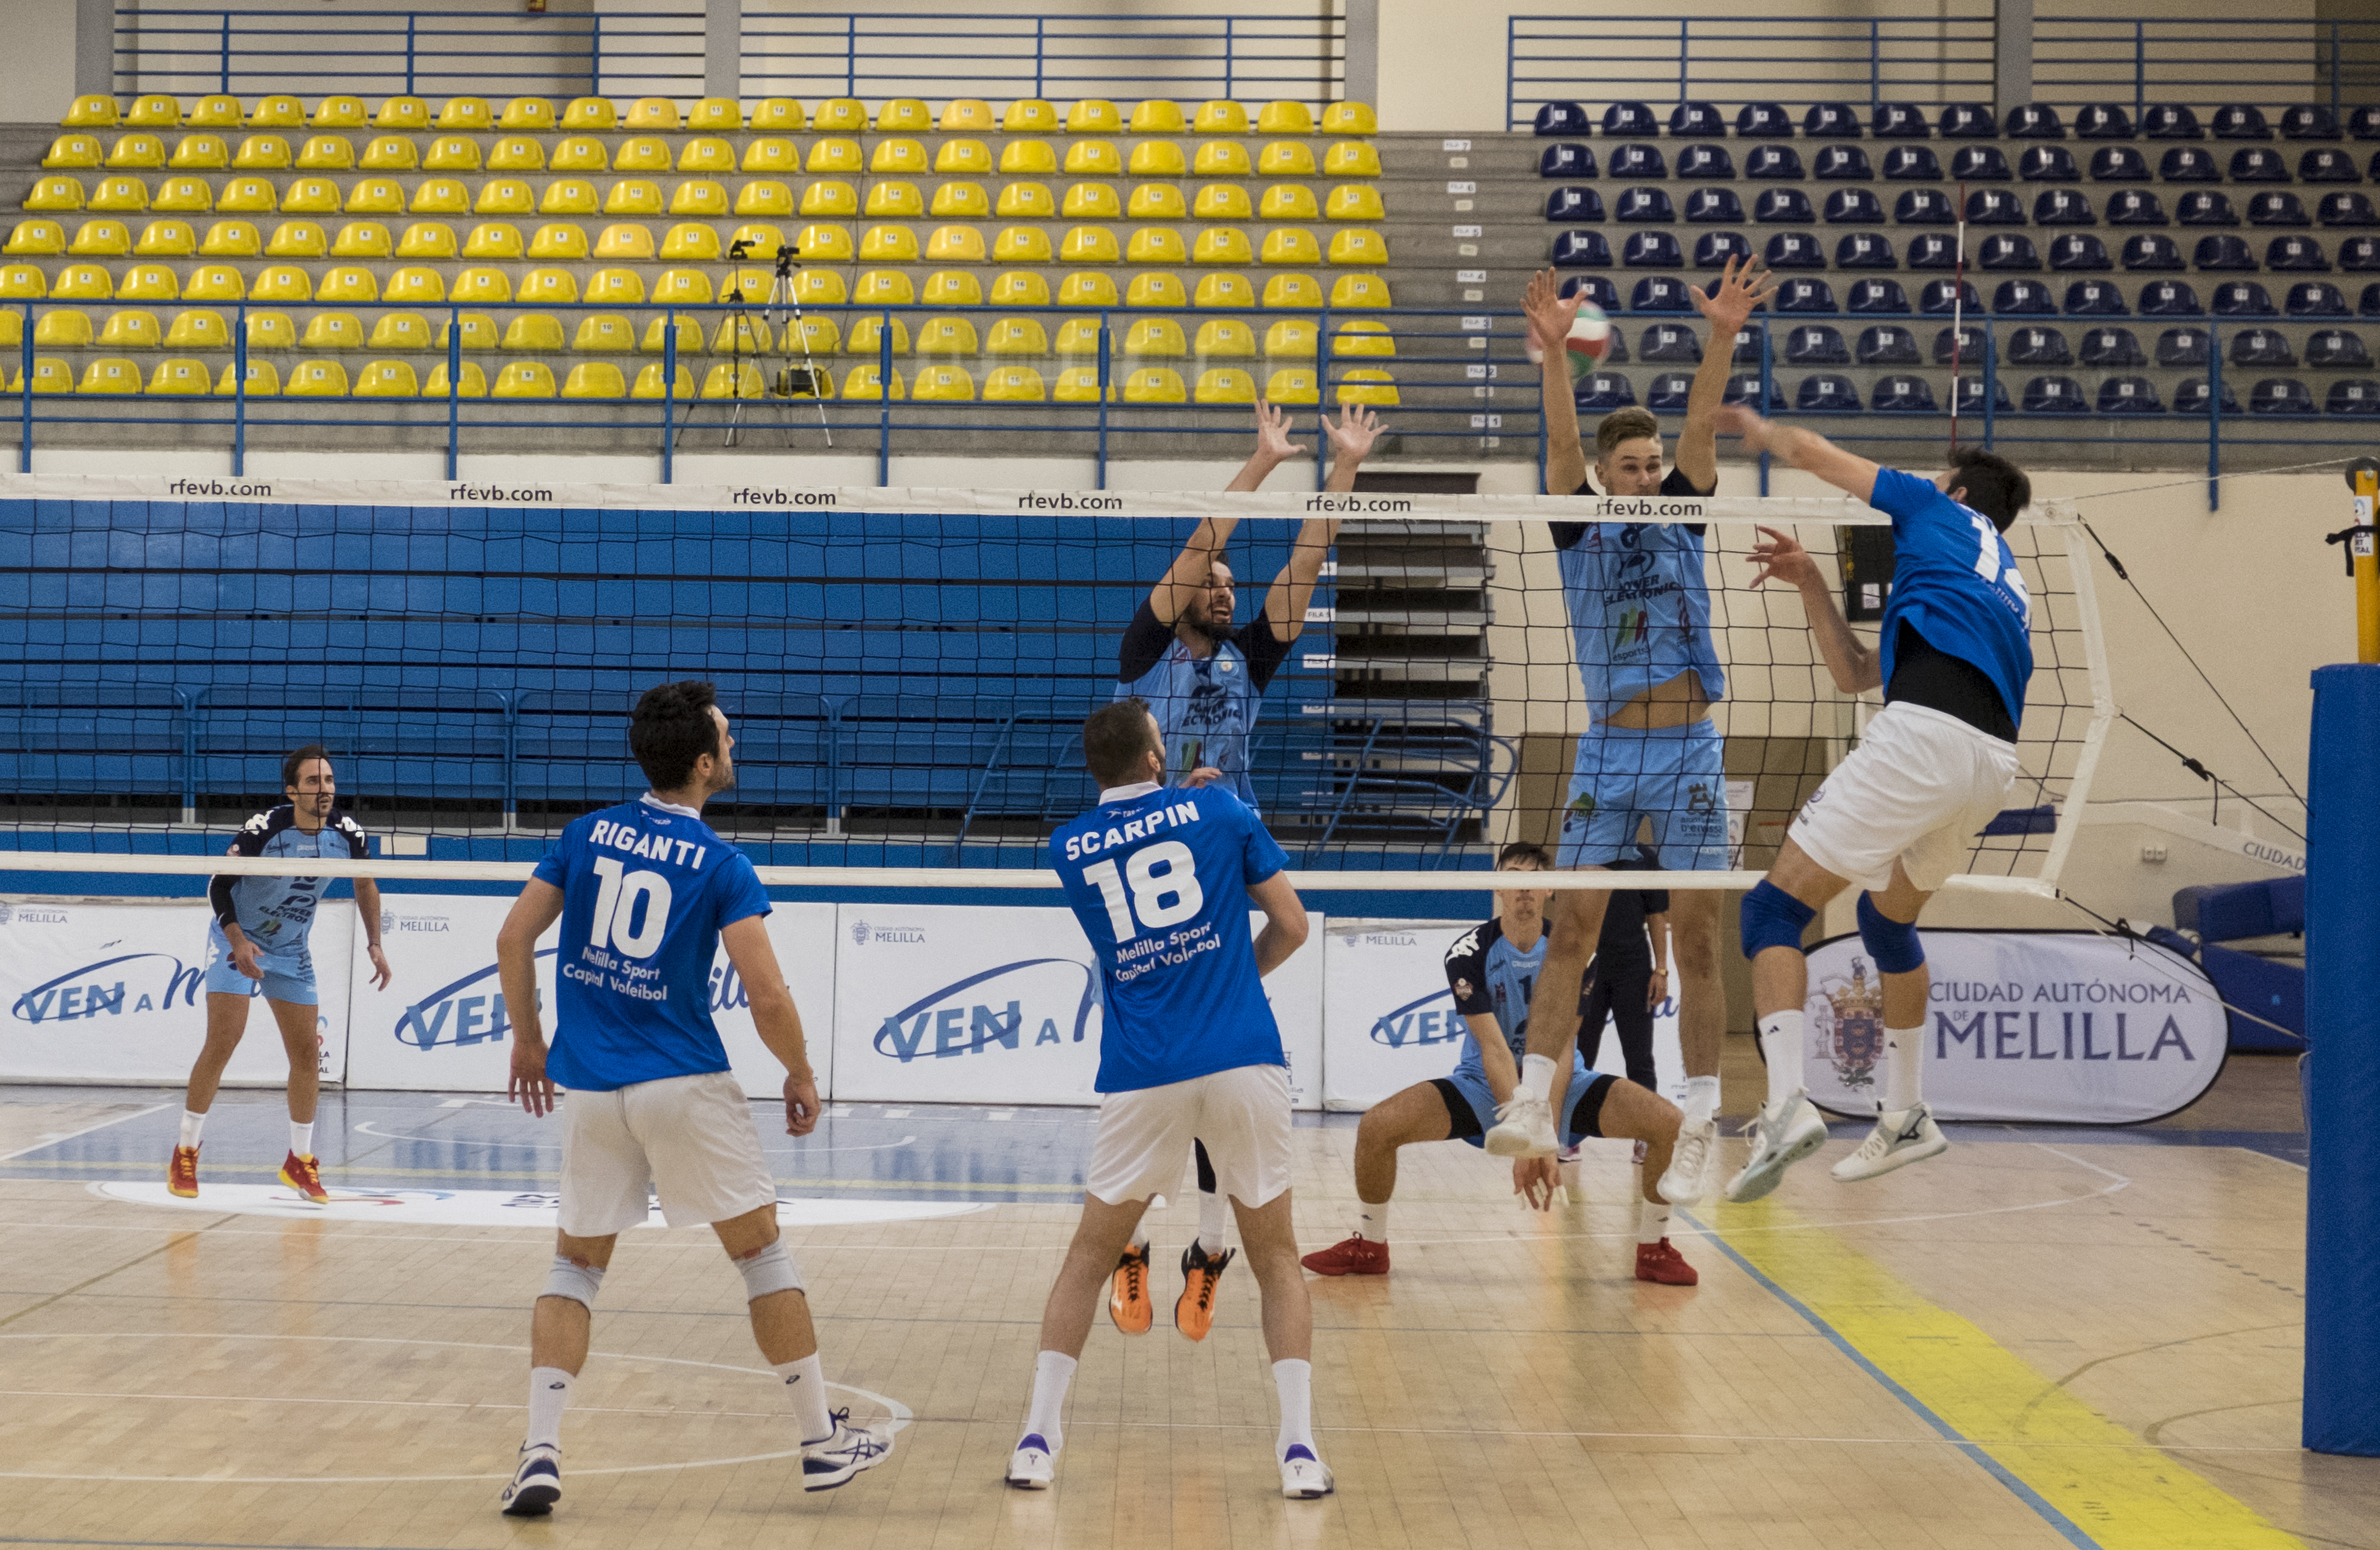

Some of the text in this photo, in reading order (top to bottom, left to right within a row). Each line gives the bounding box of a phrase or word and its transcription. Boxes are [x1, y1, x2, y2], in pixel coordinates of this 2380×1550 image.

[170, 478, 271, 496] rfevb.com
[451, 483, 553, 502] rfevb.com
[733, 487, 836, 505] rfevb.com
[1019, 492, 1122, 509] rfevb.com
[1306, 495, 1411, 512] rfevb.com
[1596, 498, 1703, 517] rfevb.com
[1065, 800, 1201, 861] SCARPIN
[588, 819, 706, 870] RIGANTI
[2243, 841, 2307, 870] CIUDAD
[1081, 840, 1204, 945] 18
[18, 913, 68, 923] MELILLA
[590, 855, 673, 959] 10
[400, 921, 450, 932] MELILLA
[875, 932, 925, 943] MELILLA
[1116, 938, 1165, 964] Melilla
[1159, 934, 1221, 966] Volebol
[1365, 935, 1418, 946] MELILLA
[621, 960, 660, 980] Sport
[610, 975, 668, 1001] Voleibol
[1928, 978, 2192, 1004] CIUDAD AUTÓNOMA
[21, 981, 125, 1025] VEN
[133, 993, 154, 1013] A
[1953, 1010, 1969, 1021] DE
[883, 1000, 1021, 1063] VEN
[1035, 1018, 1061, 1046] A
[1933, 1010, 2196, 1061] MELILLA
